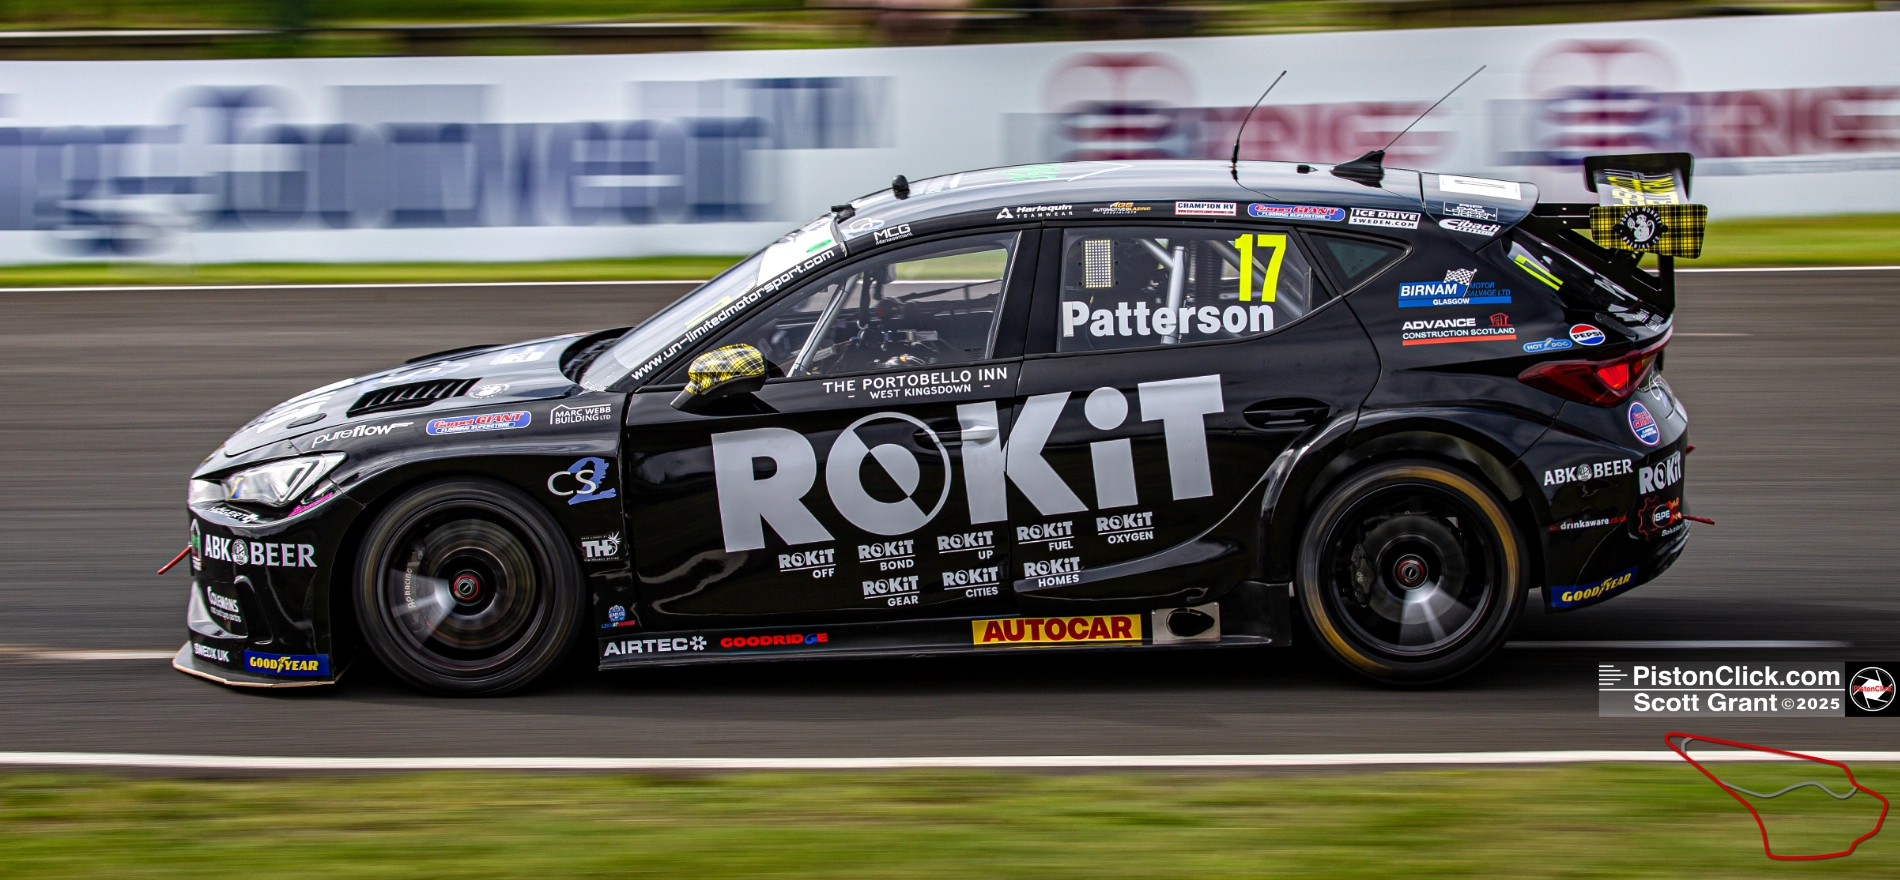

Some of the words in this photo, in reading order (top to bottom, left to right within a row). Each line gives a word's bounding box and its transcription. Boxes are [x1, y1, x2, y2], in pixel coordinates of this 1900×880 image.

[1016, 203, 1073, 213] Harlequin
[1177, 202, 1221, 210] CHAMPION
[1293, 205, 1338, 215] GIANT
[1016, 210, 1074, 219] TEAMWEAR
[1290, 212, 1326, 220] SUPERSTORE
[1355, 209, 1376, 218] ICE
[1377, 210, 1417, 221] DRIVE
[1353, 217, 1415, 228] SWEDEN.COM
[1438, 218, 1502, 234] Eibach
[873, 223, 911, 241] MCG
[875, 231, 914, 246] Management
[1234, 233, 1287, 303] 17
[1400, 283, 1458, 297] BIRNAM
[1469, 281, 1495, 289] MOTOR
[1466, 289, 1497, 297] SALVAGE
[1498, 288, 1511, 296] LTD
[1432, 297, 1470, 306] GLASGOW
[630, 249, 836, 382] www.un-limitedmotorsport.com
[1062, 301, 1274, 338] Patterson
[1402, 317, 1476, 331] ADVANCE
[1402, 328, 1470, 340] CONSTRUCTION
[1470, 326, 1516, 336] SCOTLAND
[1573, 331, 1604, 340] PEPSI
[1526, 343, 1543, 351] HOT
[1551, 341, 1569, 349] DOG
[822, 380, 856, 393] THE
[862, 370, 972, 390] PORTOBELLO
[978, 367, 1008, 381] INN
[869, 389, 900, 399] WEST
[904, 384, 972, 397] KINGSDOWN
[475, 411, 523, 425] GIANT
[555, 409, 582, 418] MARC
[585, 406, 611, 415] WEBB
[555, 414, 599, 425] BUILDING
[311, 422, 404, 449] pureflow
[710, 374, 1225, 553] ROKiT
[1543, 466, 1578, 486] ABK
[1593, 458, 1634, 478] BEER
[1096, 511, 1153, 532] ROKiT
[1016, 520, 1073, 541] ROKiT
[1107, 531, 1154, 544] OXYGEN
[937, 530, 994, 550] ROKiT
[1048, 540, 1074, 551] FUEL
[204, 533, 233, 562] ABK
[249, 541, 318, 568] BEER
[581, 539, 618, 558] THD
[857, 539, 914, 559] ROKiT
[978, 550, 994, 560] UP
[778, 549, 835, 569] ROKiT
[880, 559, 915, 571] BOND
[812, 568, 835, 579] OFF
[1023, 556, 1080, 578] ROKiT
[942, 566, 999, 587] ROKiT
[1037, 574, 1080, 588] HOMES
[862, 575, 919, 595] ROKiT
[965, 586, 999, 598] CITIES
[1561, 572, 1633, 603] GOODYEAR
[887, 595, 919, 607] GEAR
[982, 616, 1133, 642] AUTOCAR
[603, 638, 689, 656] AIRTEC
[720, 633, 828, 648] GOODRIDGE
[217, 648, 230, 662] UK
[250, 656, 319, 674] GOODYEAR
